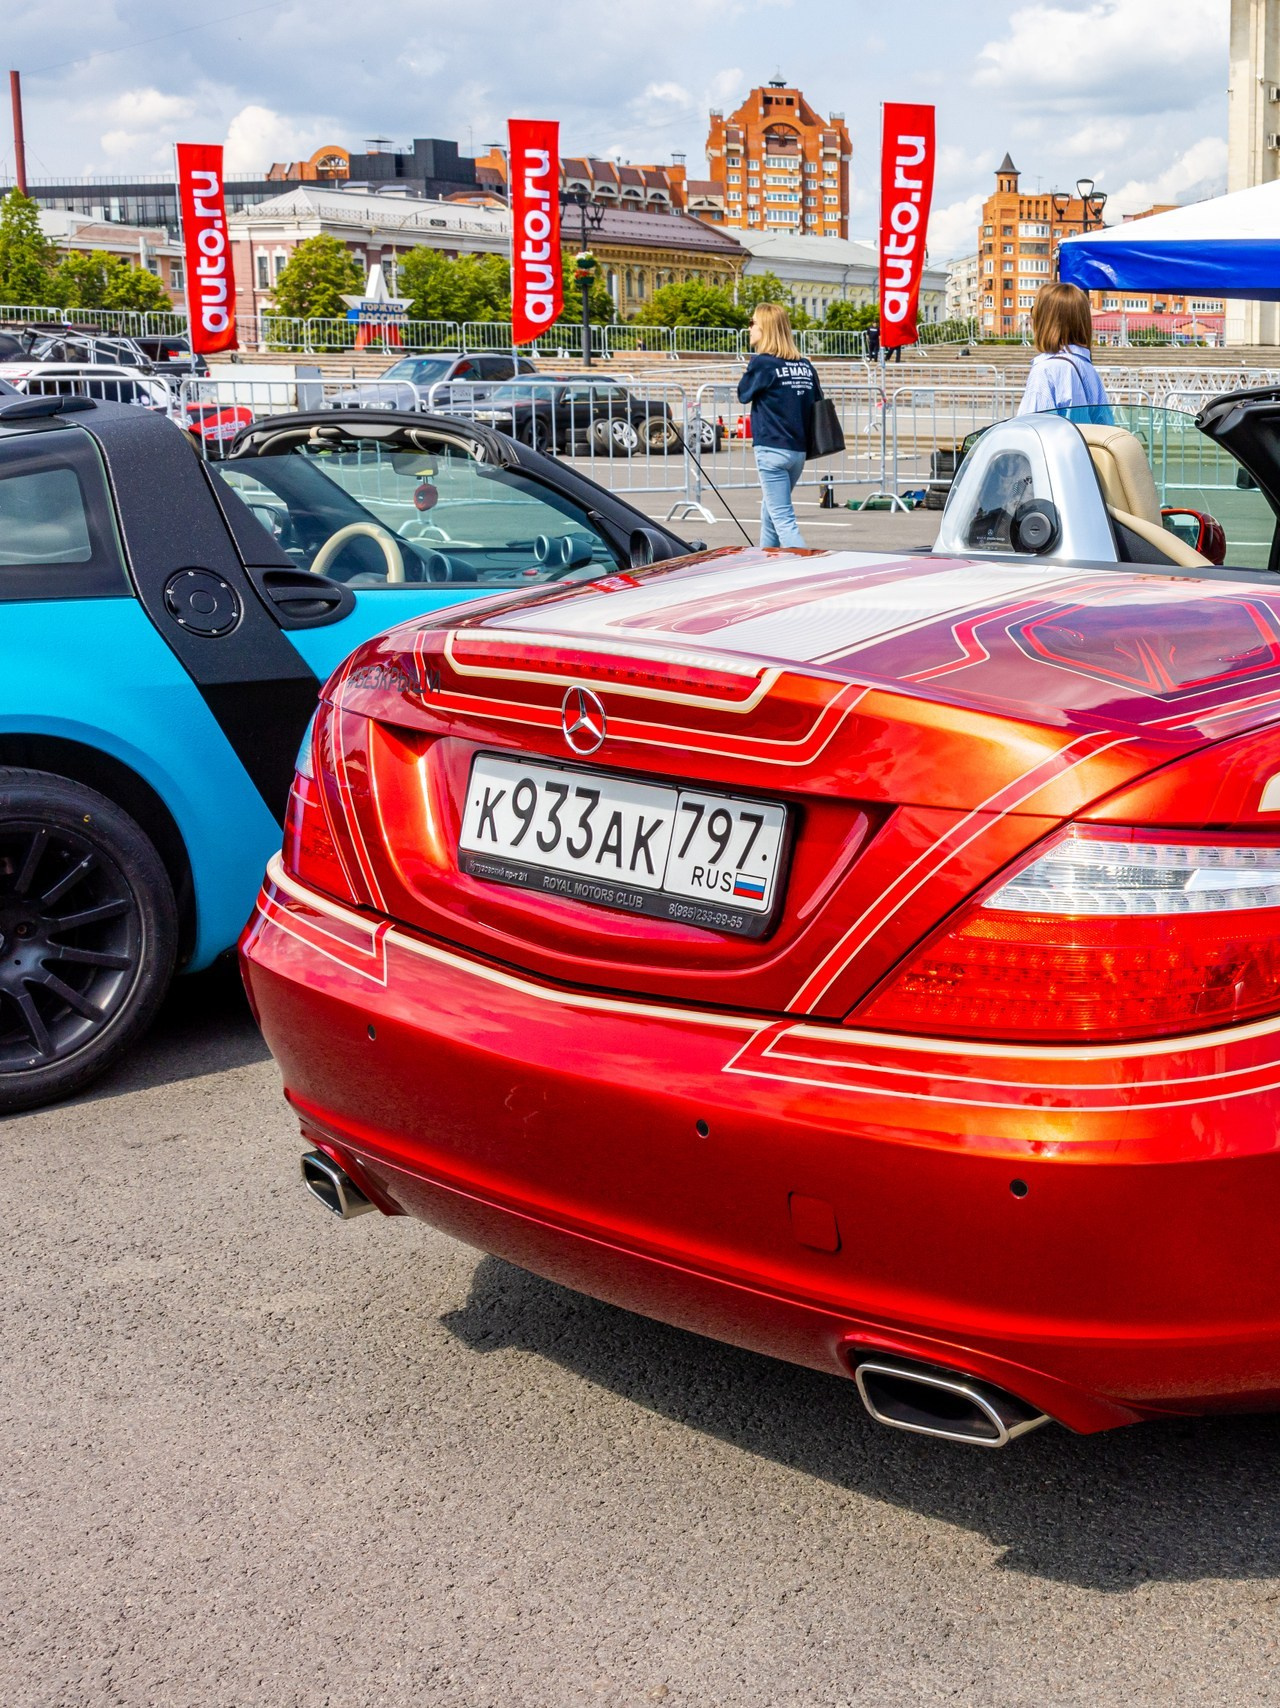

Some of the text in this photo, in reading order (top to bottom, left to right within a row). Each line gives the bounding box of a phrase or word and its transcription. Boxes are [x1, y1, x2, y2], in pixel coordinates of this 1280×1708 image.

[521, 149, 554, 323] auto.ru
[884, 135, 926, 322] auto.ru
[191, 170, 229, 333] auto.ru
[363, 304, 403, 313] ГОРЖУСЬ
[775, 367, 790, 378] LE
[477, 778, 764, 874] К933АК 797
[542, 875, 644, 909] ROYAL MOTORS CLUB
[690, 865, 732, 893] RUS
[668, 902, 743, 928] 8(985)233-99-55
